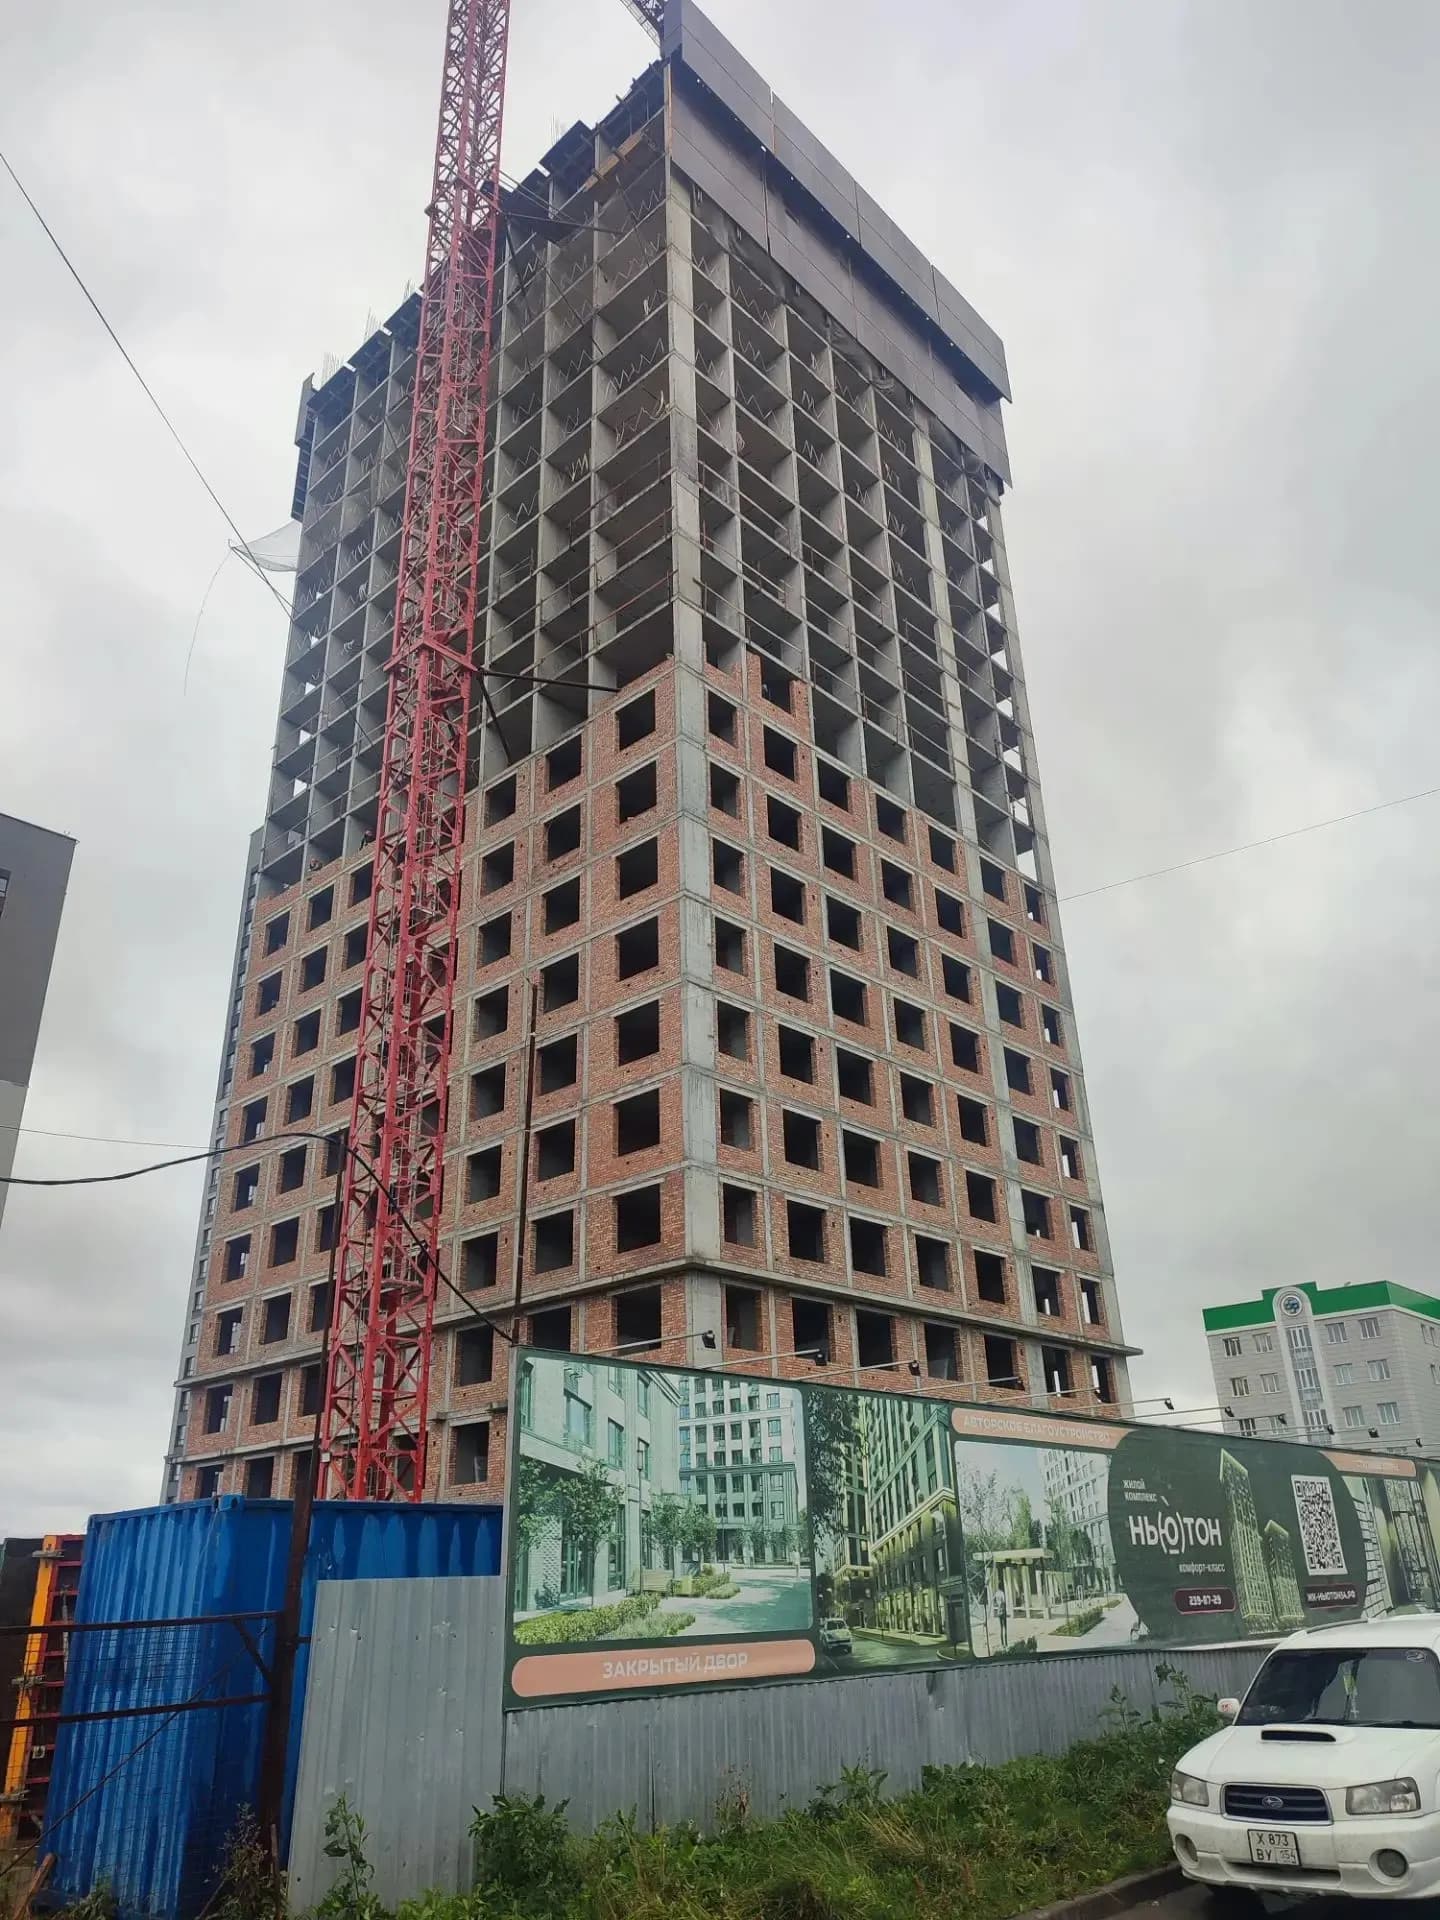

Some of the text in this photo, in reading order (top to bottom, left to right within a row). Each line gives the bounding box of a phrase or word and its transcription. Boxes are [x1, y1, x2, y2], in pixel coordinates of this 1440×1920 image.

[603, 1652, 748, 1678] ЗАКРЫТЫЙ ДВОР
[1268, 1833, 1288, 1846] 873
